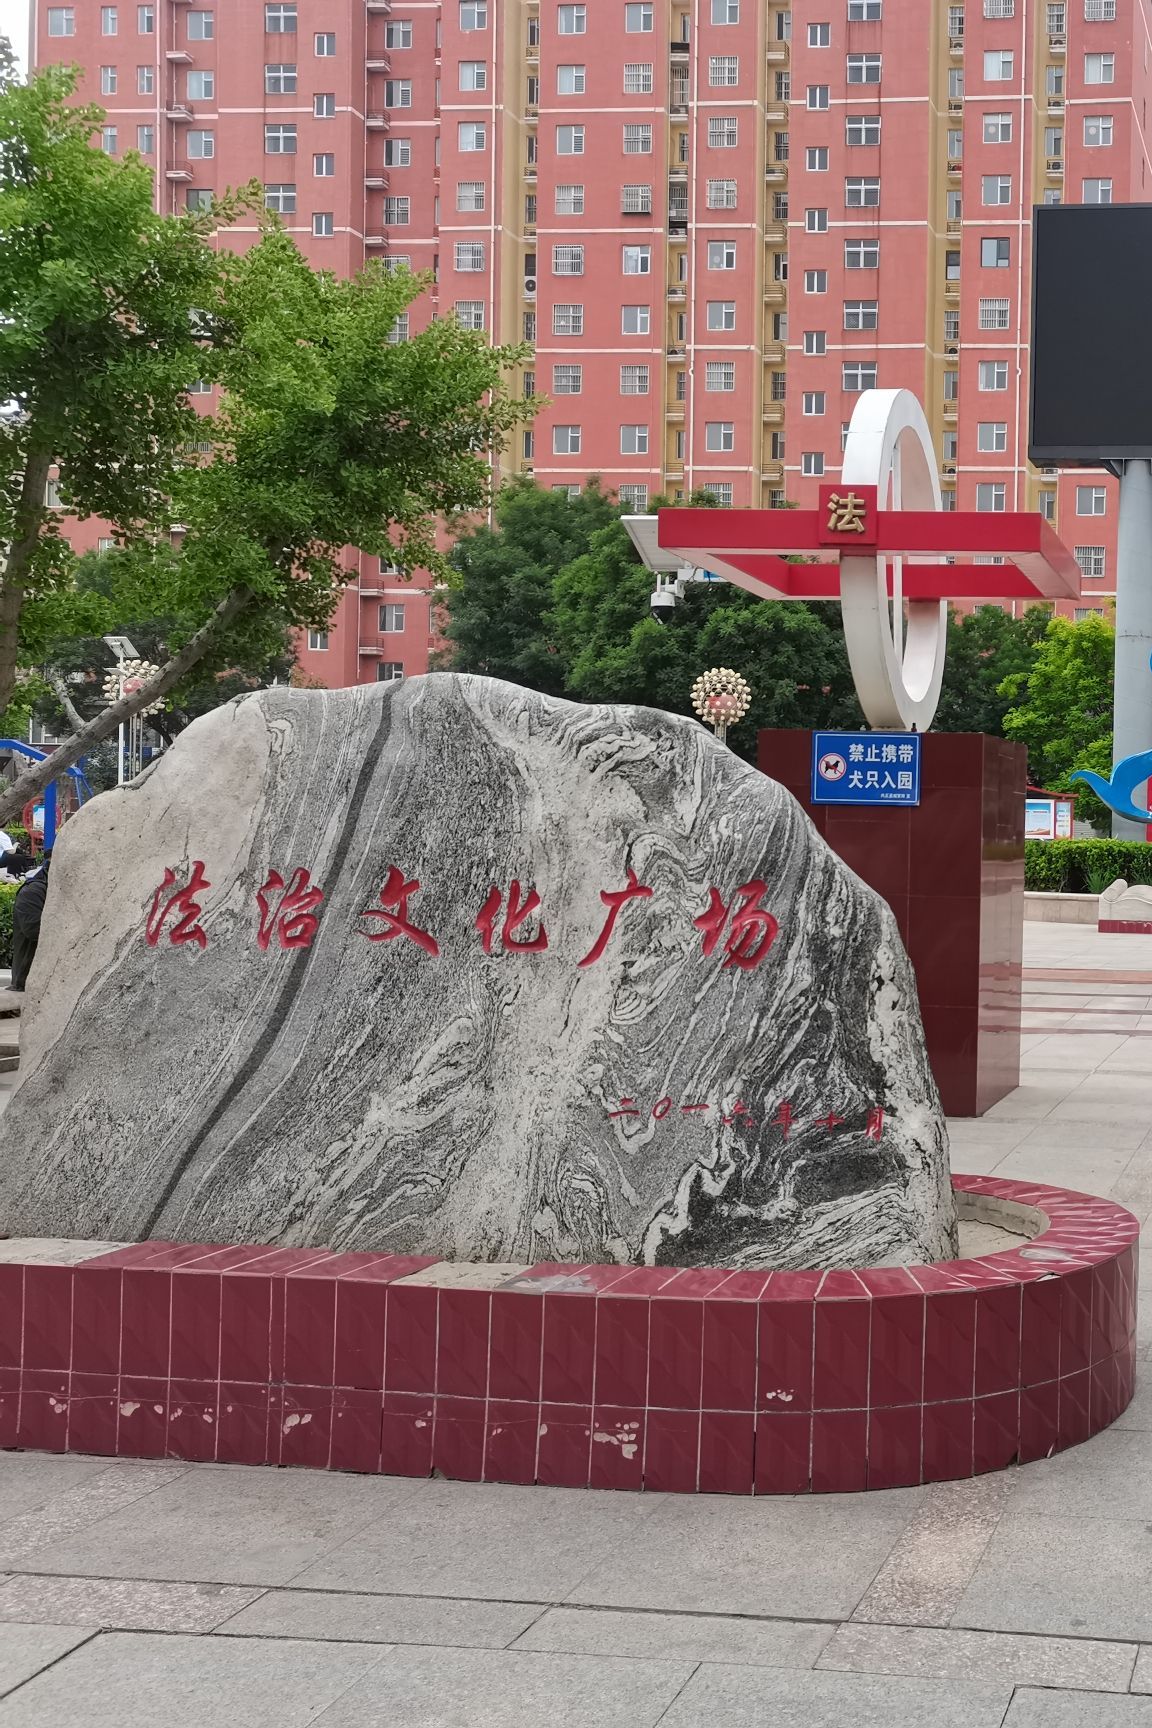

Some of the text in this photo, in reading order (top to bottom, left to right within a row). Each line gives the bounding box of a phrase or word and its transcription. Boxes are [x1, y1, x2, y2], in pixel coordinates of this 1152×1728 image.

[827, 491, 866, 534] 法
[848, 743, 914, 763] 禁止携带
[847, 770, 913, 790] 犬只入园
[145, 860, 779, 970] 法治文化广场
